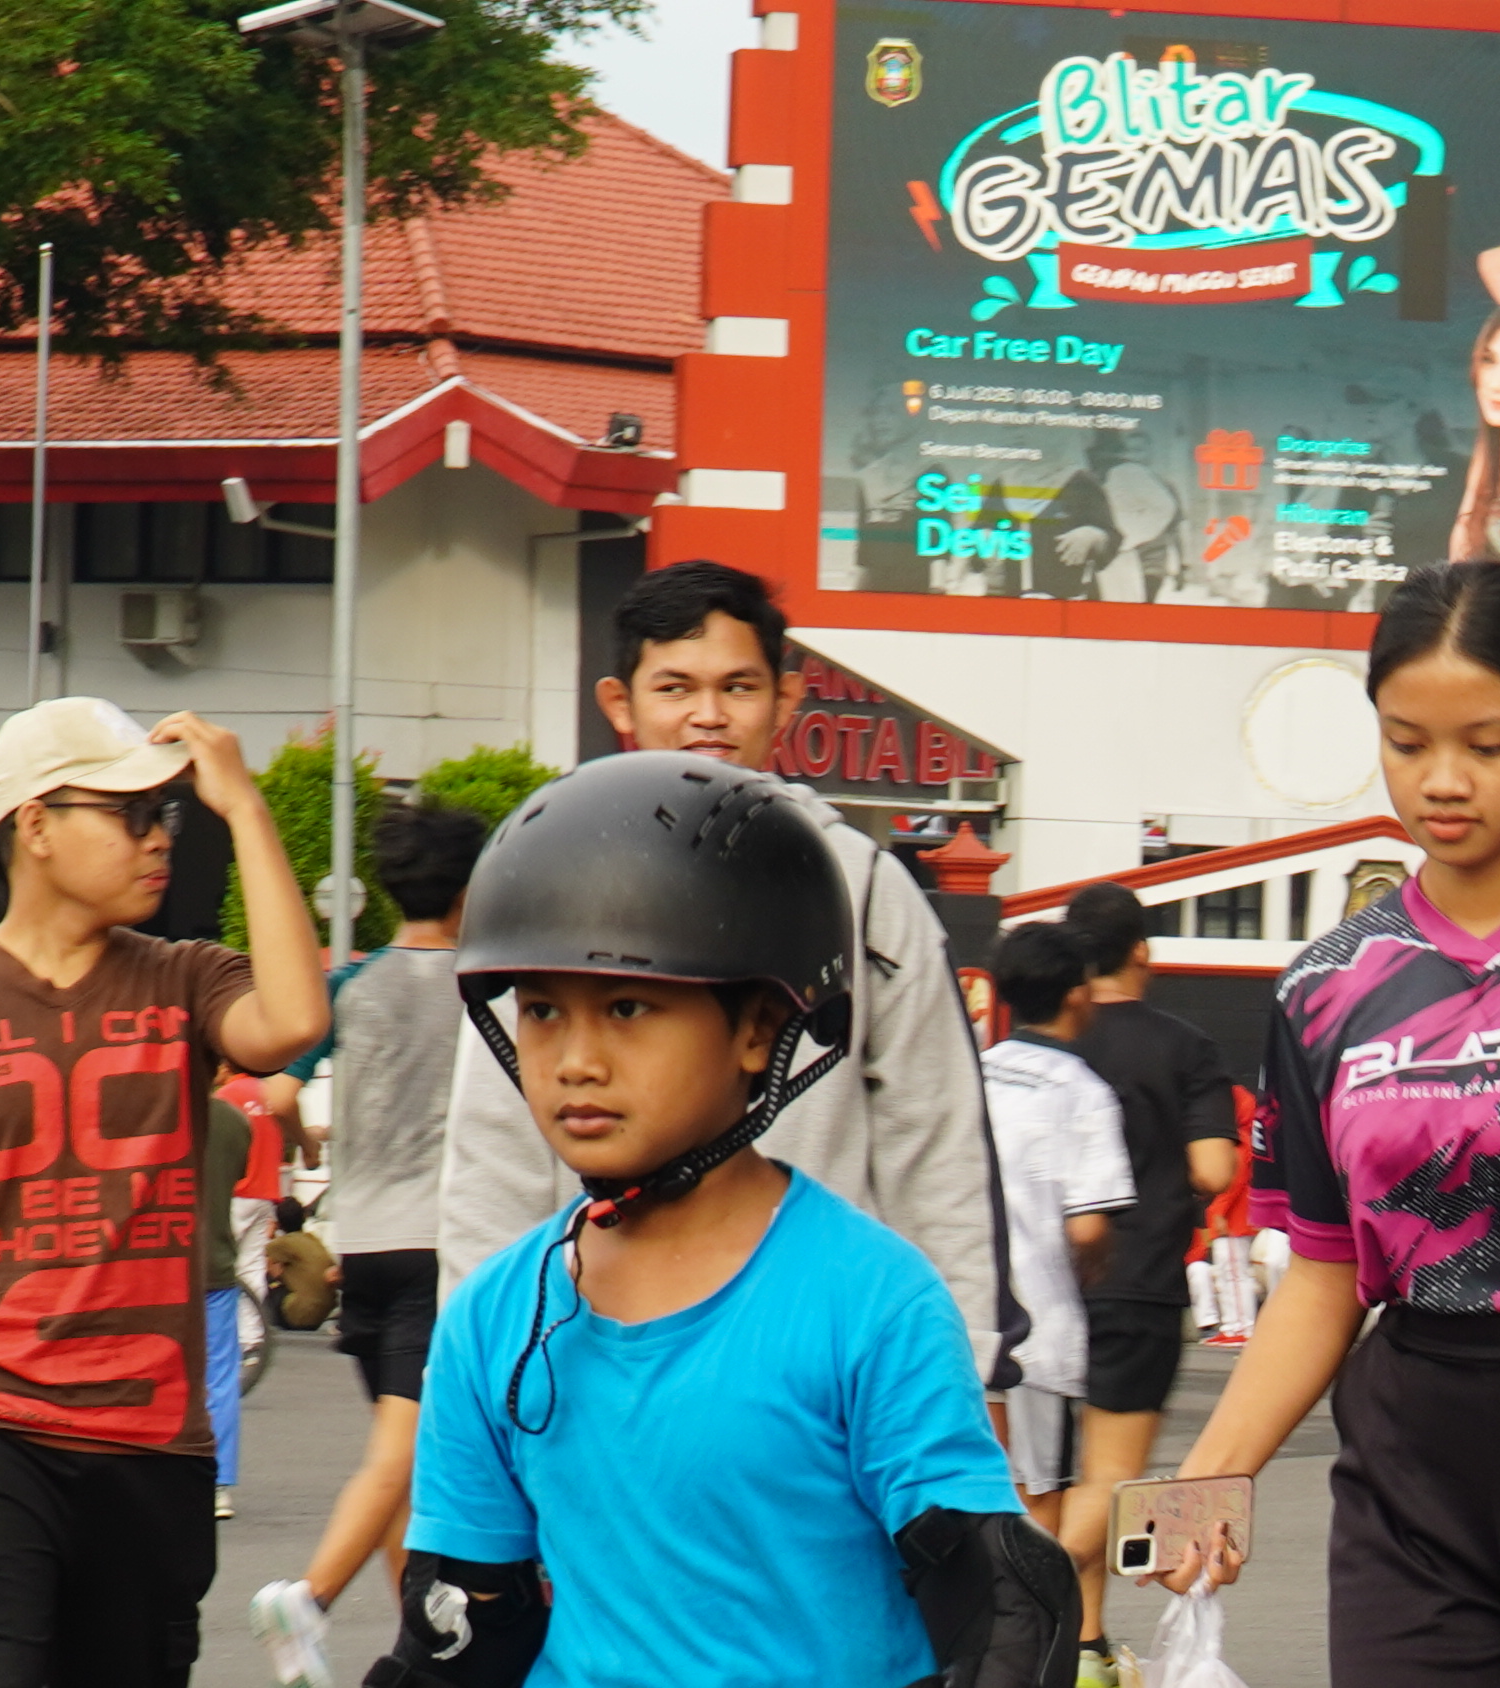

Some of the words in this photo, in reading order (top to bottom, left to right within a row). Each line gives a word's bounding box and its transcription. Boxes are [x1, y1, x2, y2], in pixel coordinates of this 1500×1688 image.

[1041, 54, 1314, 146] Blitar
[953, 128, 1396, 261] GEMAS
[905, 328, 969, 358] Car
[973, 331, 1051, 362] Free
[1055, 335, 1125, 374] Day
[915, 472, 983, 513] Sei
[1275, 502, 1370, 526] Hiburan
[916, 518, 1033, 560] Devis
[1273, 556, 1330, 578] Putri
[1331, 559, 1409, 583] Calista
[762, 709, 911, 784] KOTA
[61, 1011, 74, 1044] I
[1341, 1086, 1398, 1110] BLITAR
[1401, 1081, 1462, 1102] INLINE
[20, 1175, 101, 1220] BE
[130, 1166, 197, 1208] ME
